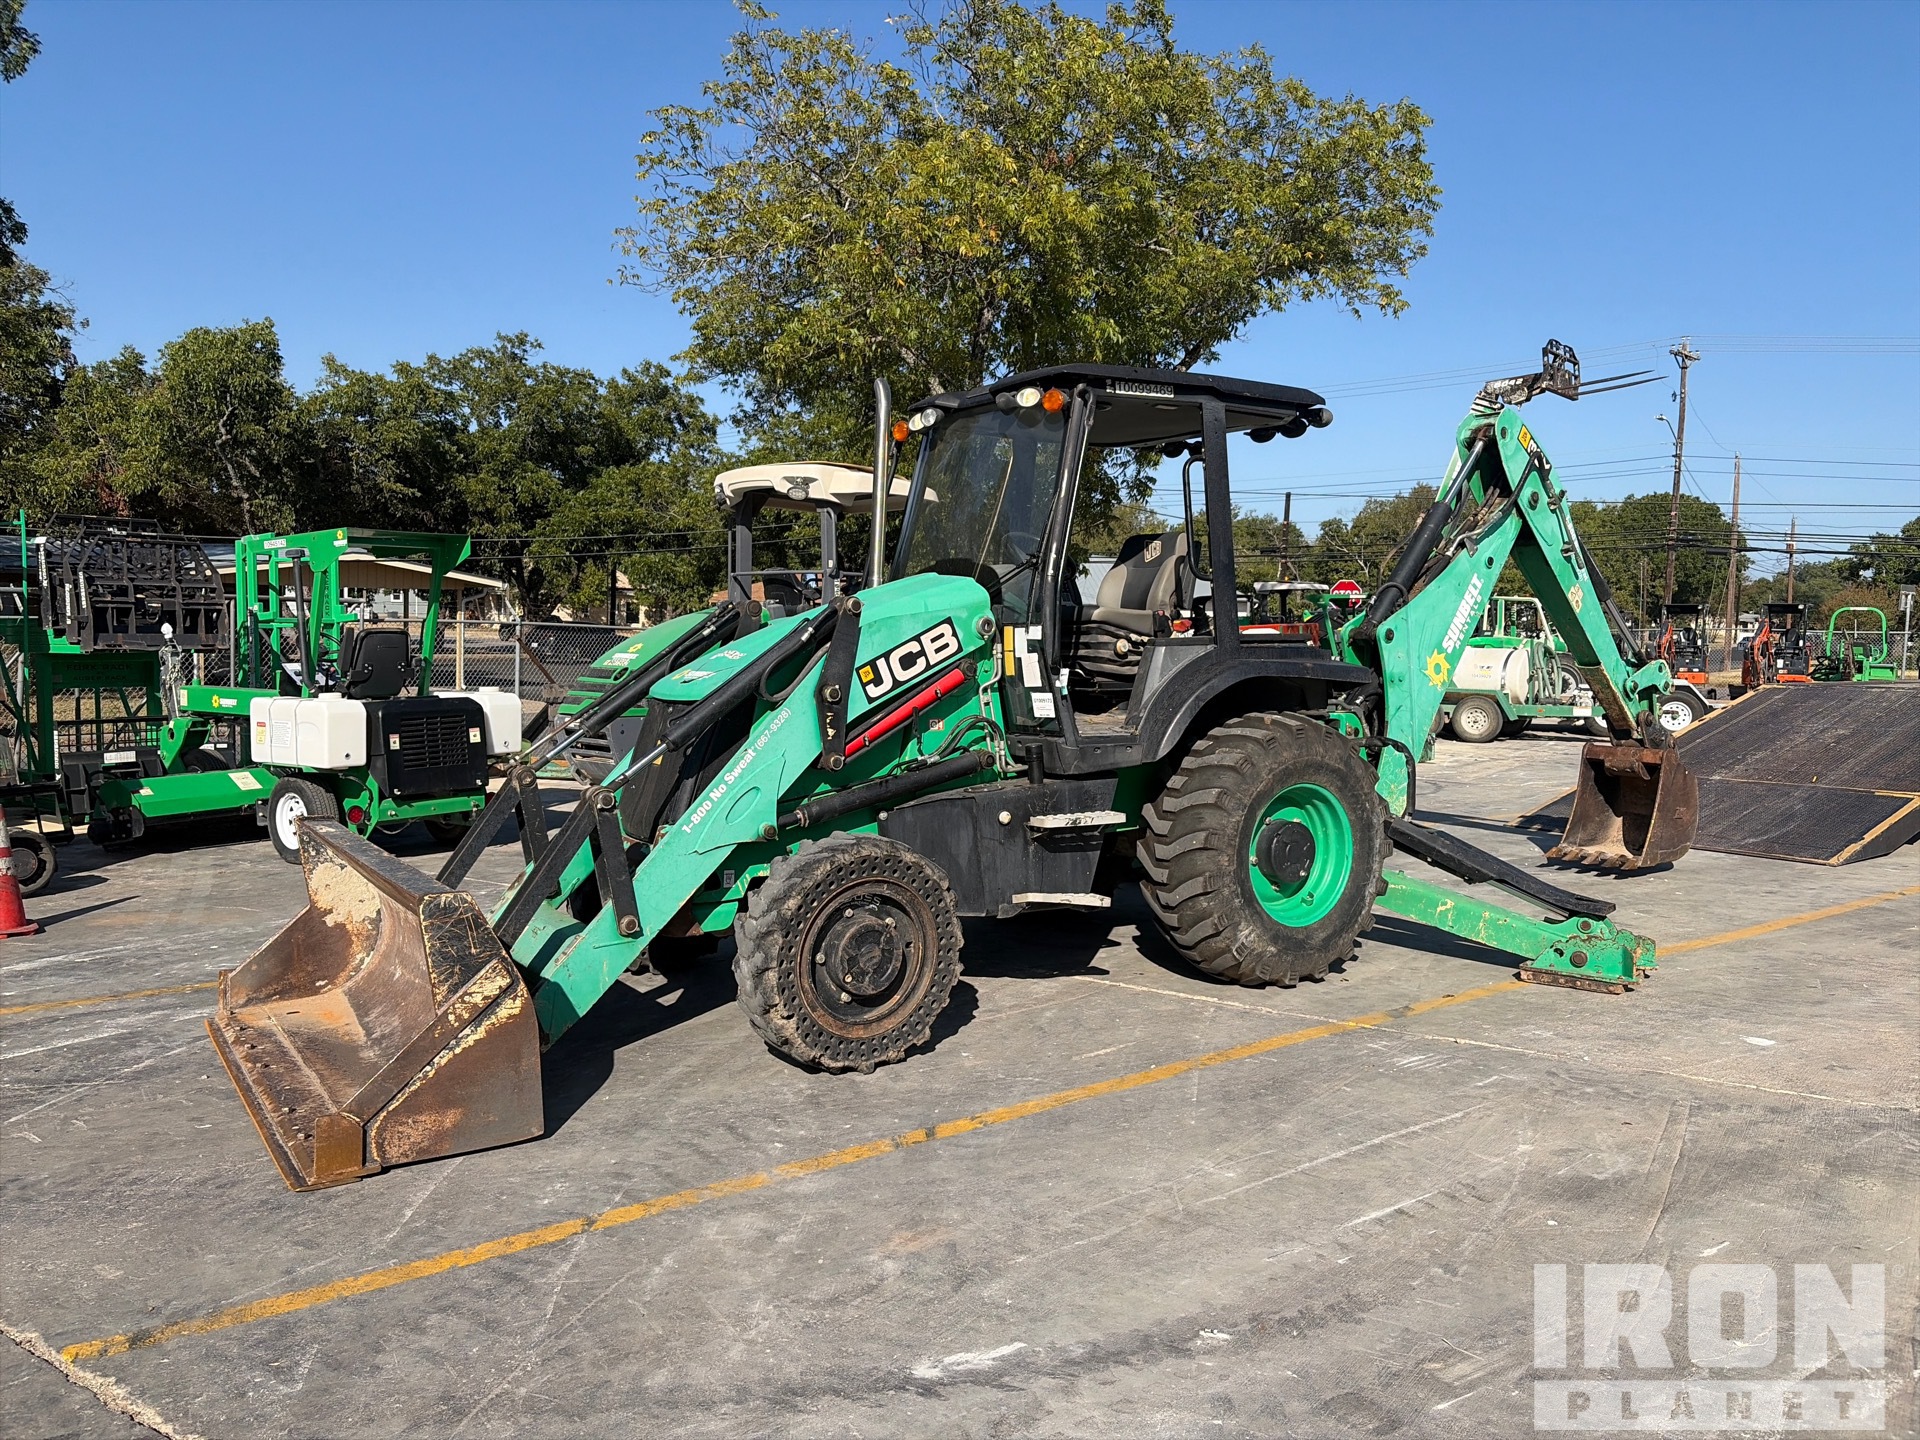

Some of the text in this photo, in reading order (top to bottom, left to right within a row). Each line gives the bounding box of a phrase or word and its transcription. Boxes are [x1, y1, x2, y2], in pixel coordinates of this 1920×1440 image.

[1116, 382, 1173, 396] 10099469
[1442, 573, 1483, 654] SUNBELT
[1455, 594, 1483, 650] RENTALS
[865, 623, 959, 698] JCB
[682, 707, 792, 834] 1-800 No Sweat (667-9328)
